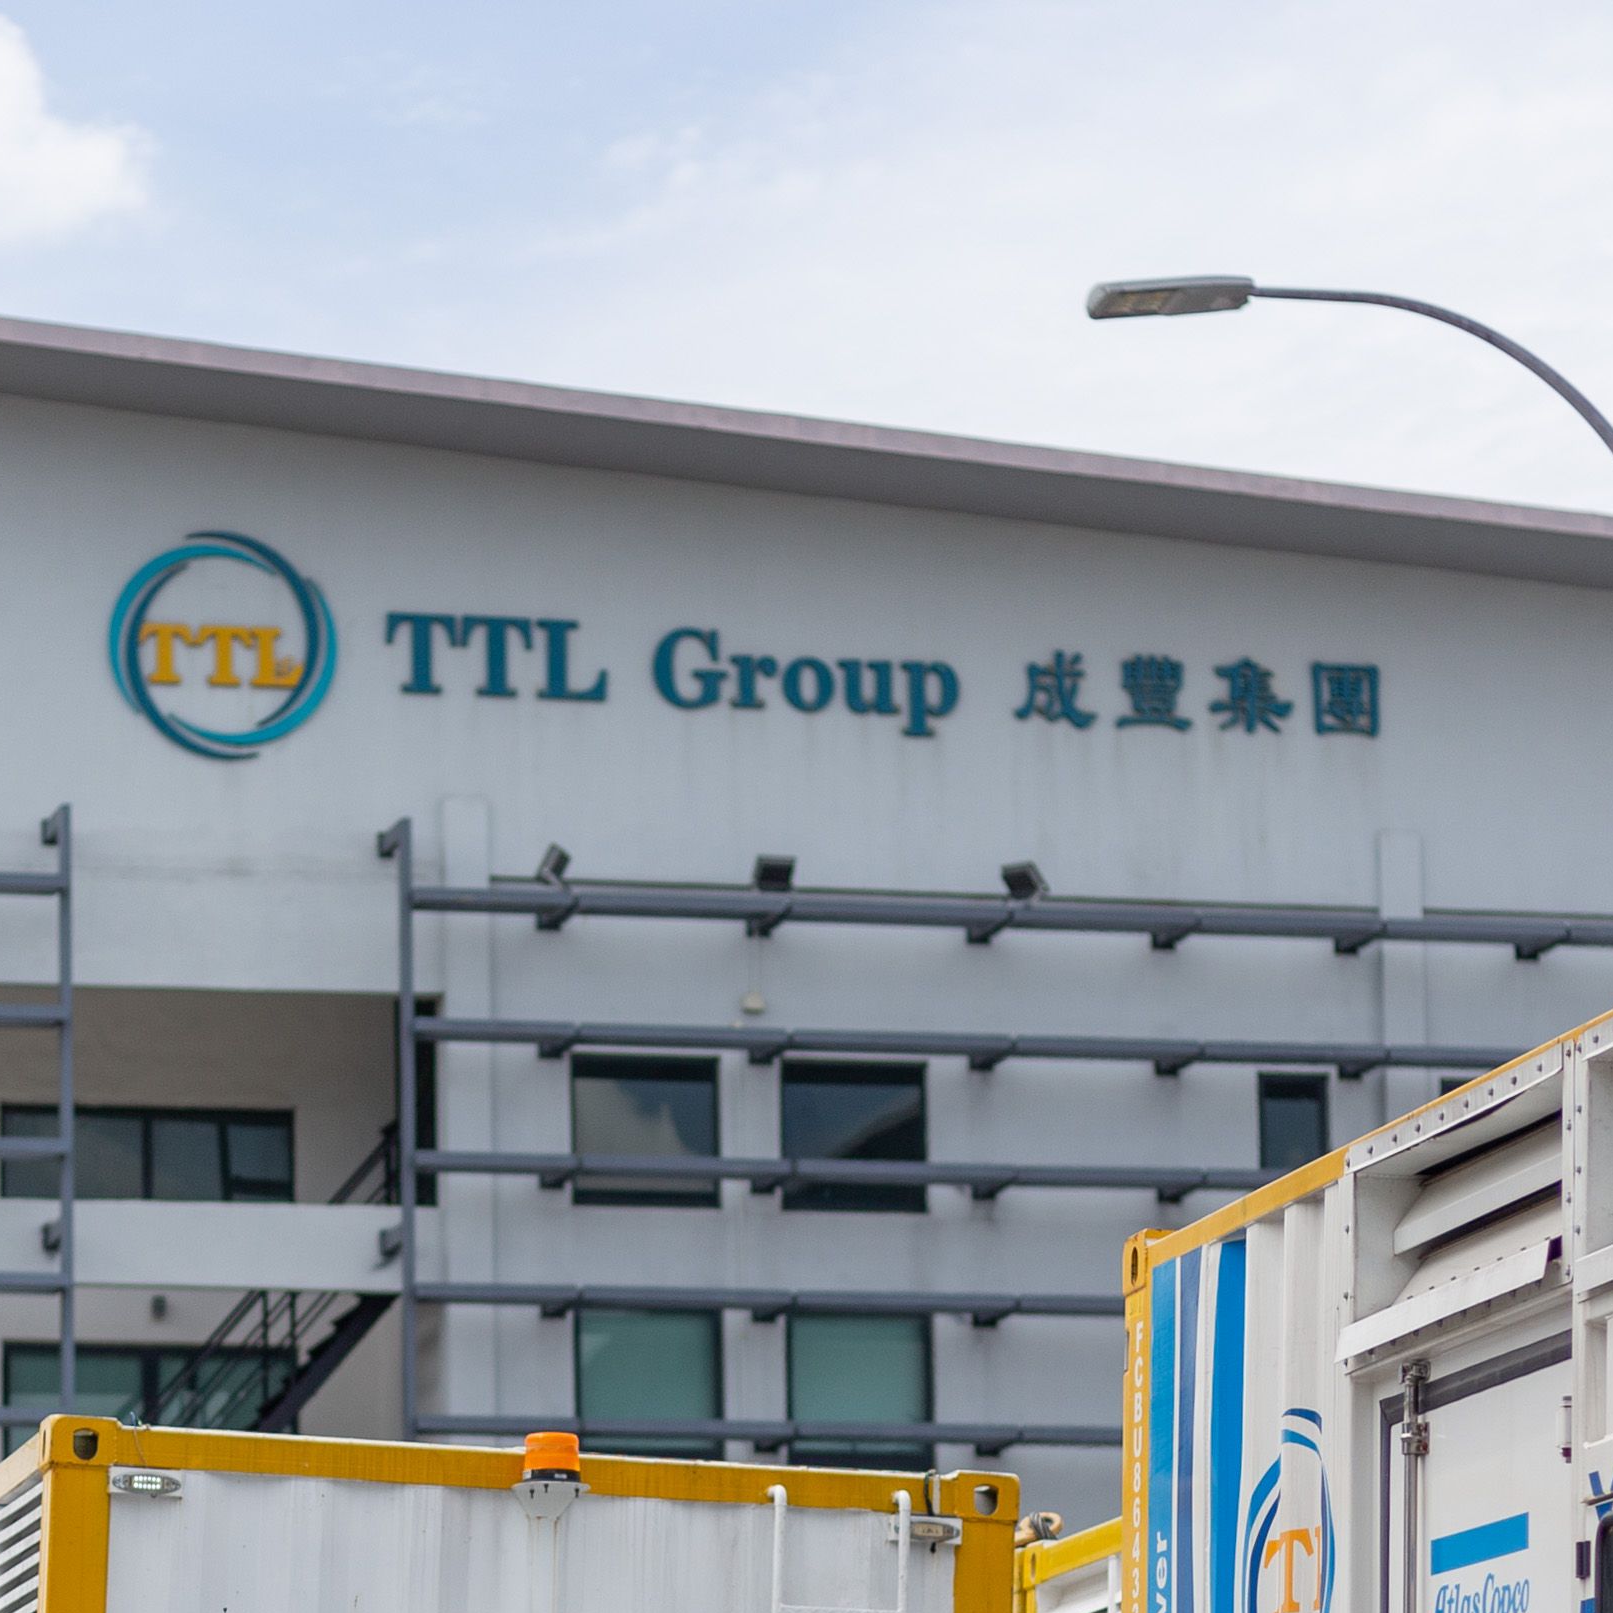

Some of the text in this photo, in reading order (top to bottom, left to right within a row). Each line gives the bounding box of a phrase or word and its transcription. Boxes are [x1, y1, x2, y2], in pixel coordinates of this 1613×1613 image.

[138, 621, 304, 688] TTL
[385, 610, 960, 738] TTL Group
[1014, 649, 1380, 738] 成豐集團
